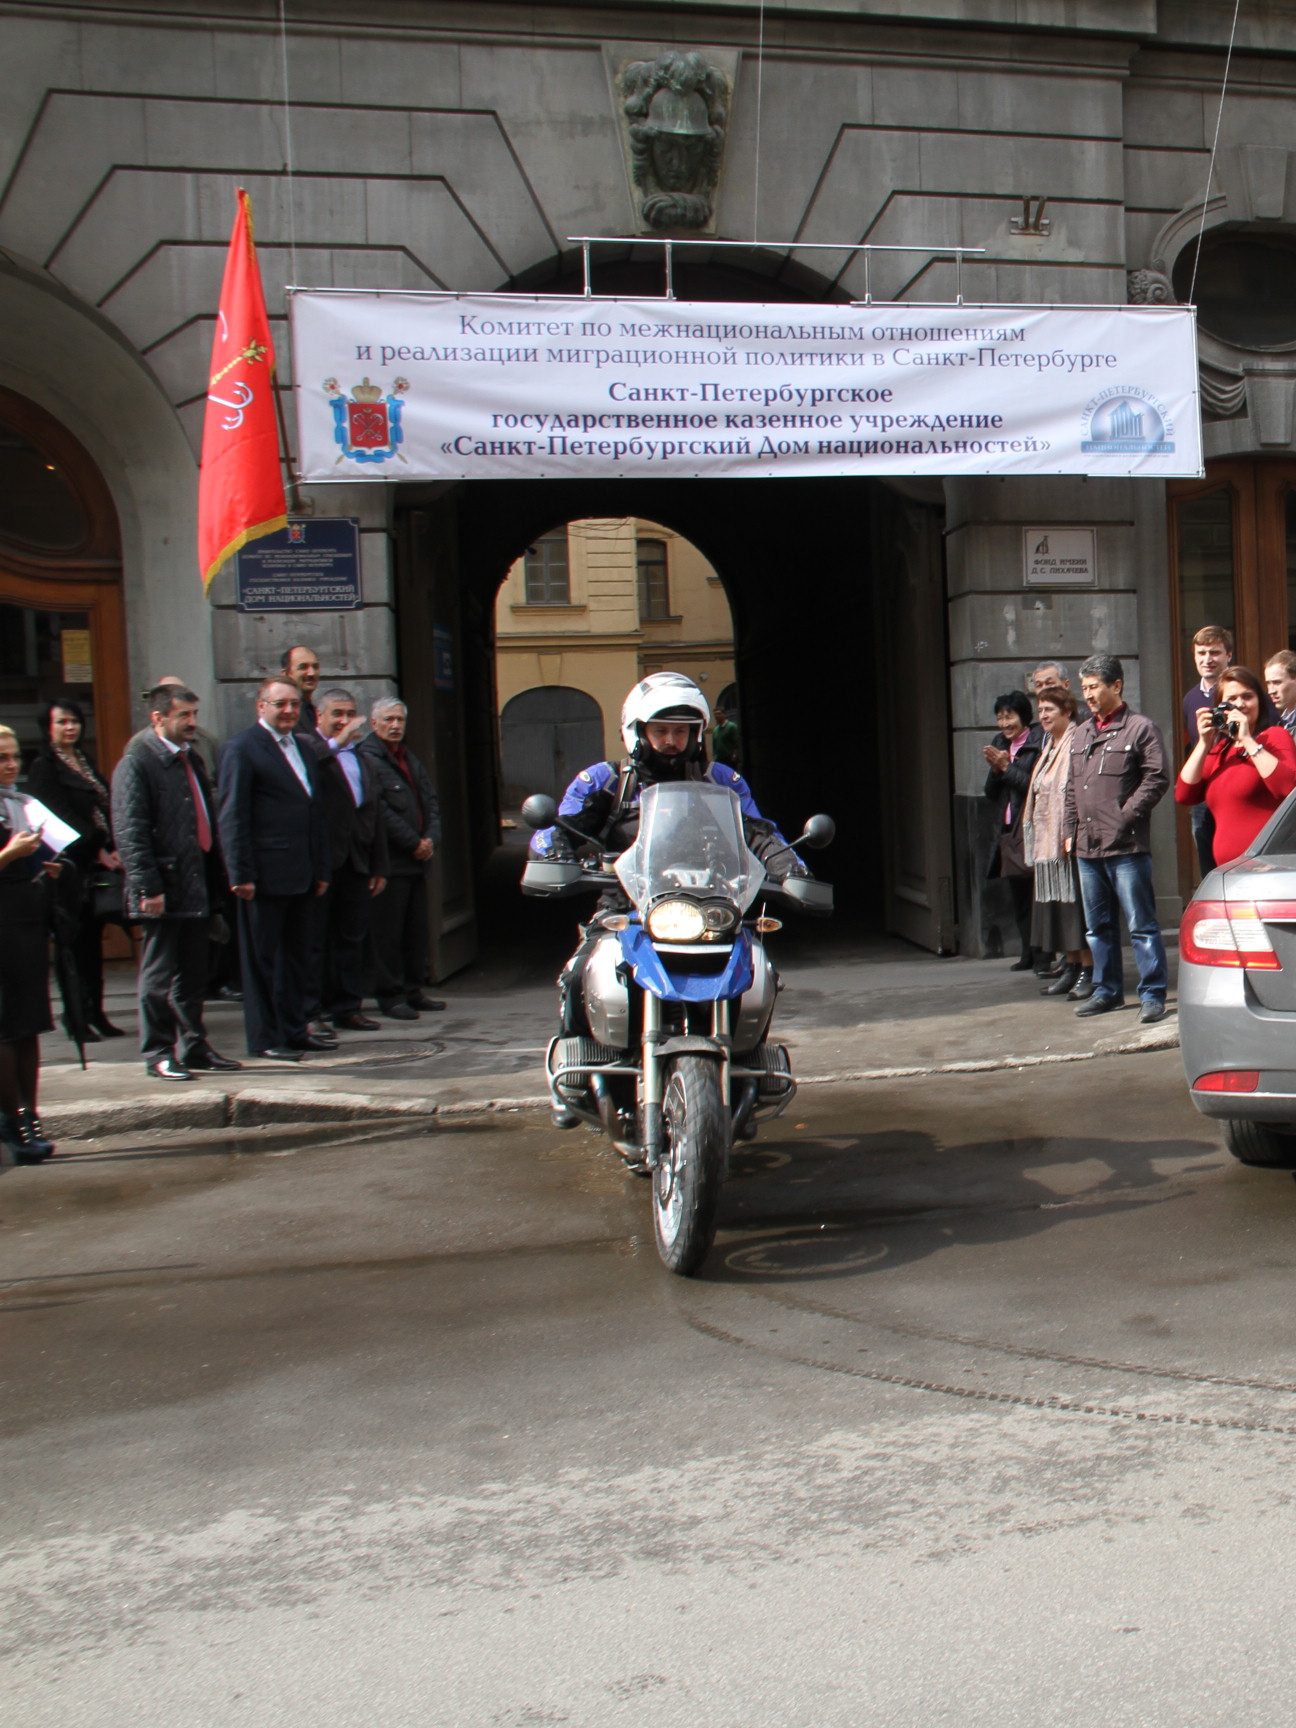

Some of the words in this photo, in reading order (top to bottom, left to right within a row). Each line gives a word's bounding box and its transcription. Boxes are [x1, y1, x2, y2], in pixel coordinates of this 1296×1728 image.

[459, 314, 574, 337] Комитет
[581, 321, 612, 338] по
[619, 322, 865, 342] межнациональным
[872, 325, 1026, 342] отношениям
[356, 345, 372, 361] и
[380, 345, 539, 366] реализации
[546, 347, 738, 368] миграционной
[745, 350, 865, 366] политики
[872, 352, 885, 366] в
[892, 348, 1117, 373] Санкт-Петербурге
[608, 382, 893, 407] Санкт-Петербургское
[491, 412, 718, 433] государственное
[725, 414, 843, 429] казенное
[851, 414, 1003, 433] учреждение
[1081, 385, 1175, 437] САНКТ-ПЕТЕРБУРГСКИЙ
[441, 435, 751, 460] «Санкт-Петербургский
[758, 436, 811, 458] Дом
[818, 436, 1051, 457] национальностей»
